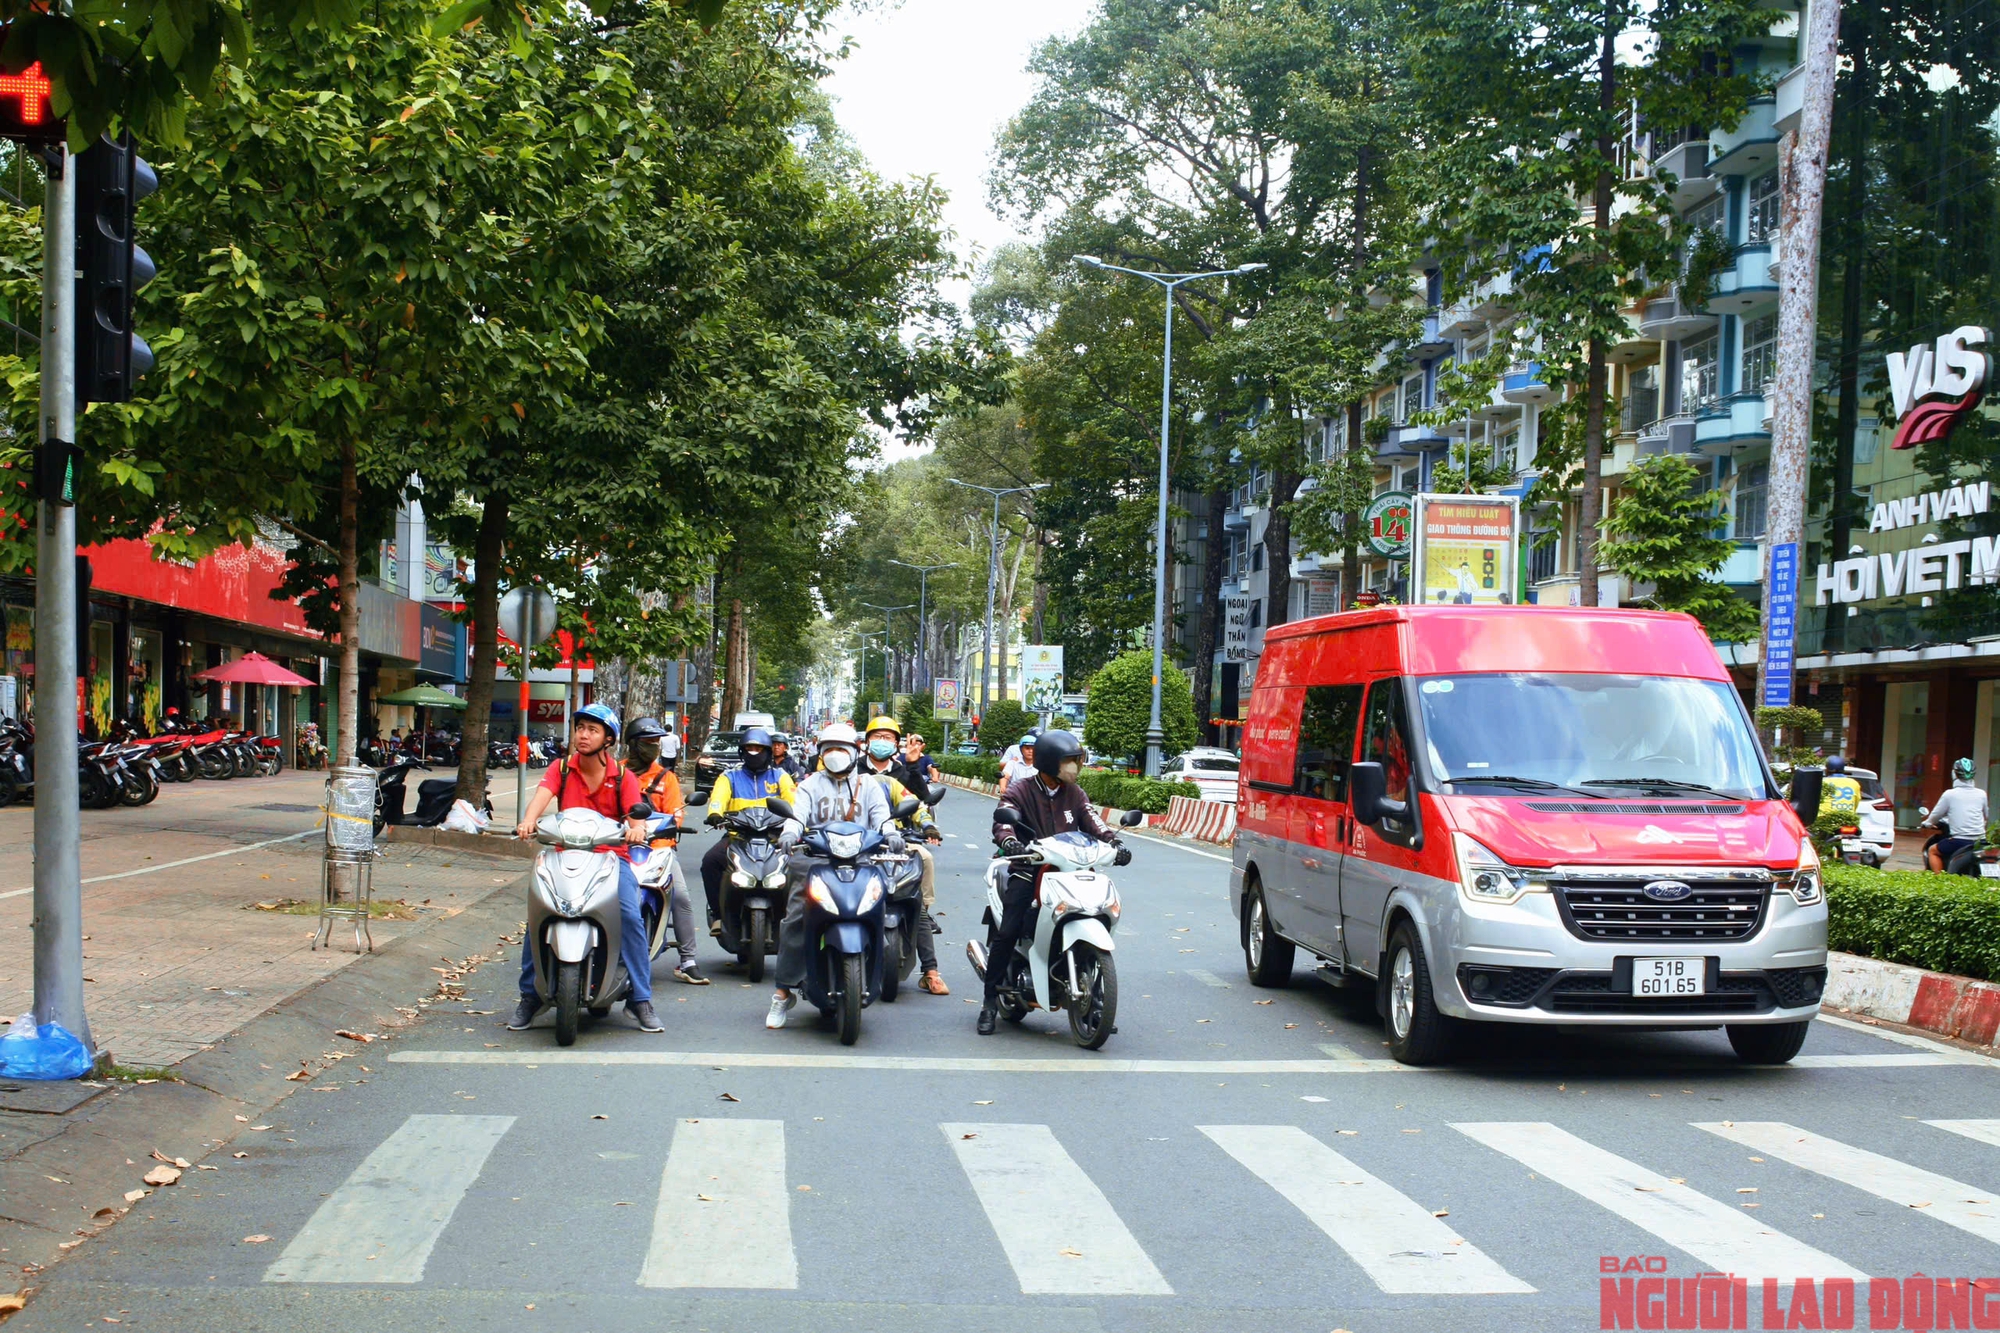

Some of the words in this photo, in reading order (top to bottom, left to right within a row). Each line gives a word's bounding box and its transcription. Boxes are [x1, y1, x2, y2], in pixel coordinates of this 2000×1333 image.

[1886, 325, 1991, 420] VUS
[1438, 507, 1454, 518] TÌM
[1479, 508, 1500, 520] LUẬT
[1868, 493, 1929, 534] ANH
[1929, 478, 1991, 521] VĂN
[1427, 524, 1445, 534] GIAO
[1446, 523, 1472, 536] THÔNG
[1473, 524, 1499, 537] ĐƯỜNG
[1501, 524, 1511, 538] BỘ
[1816, 544, 1879, 617] HỘI
[1880, 533, 1971, 608] VIỆT
[1227, 598, 1248, 610] NGOẠI
[817, 796, 863, 823] GAP
[1831, 801, 1854, 811] Food
[1655, 883, 1683, 897] Ford
[1654, 961, 1685, 977] 51B
[1641, 978, 1697, 994] 601.65
